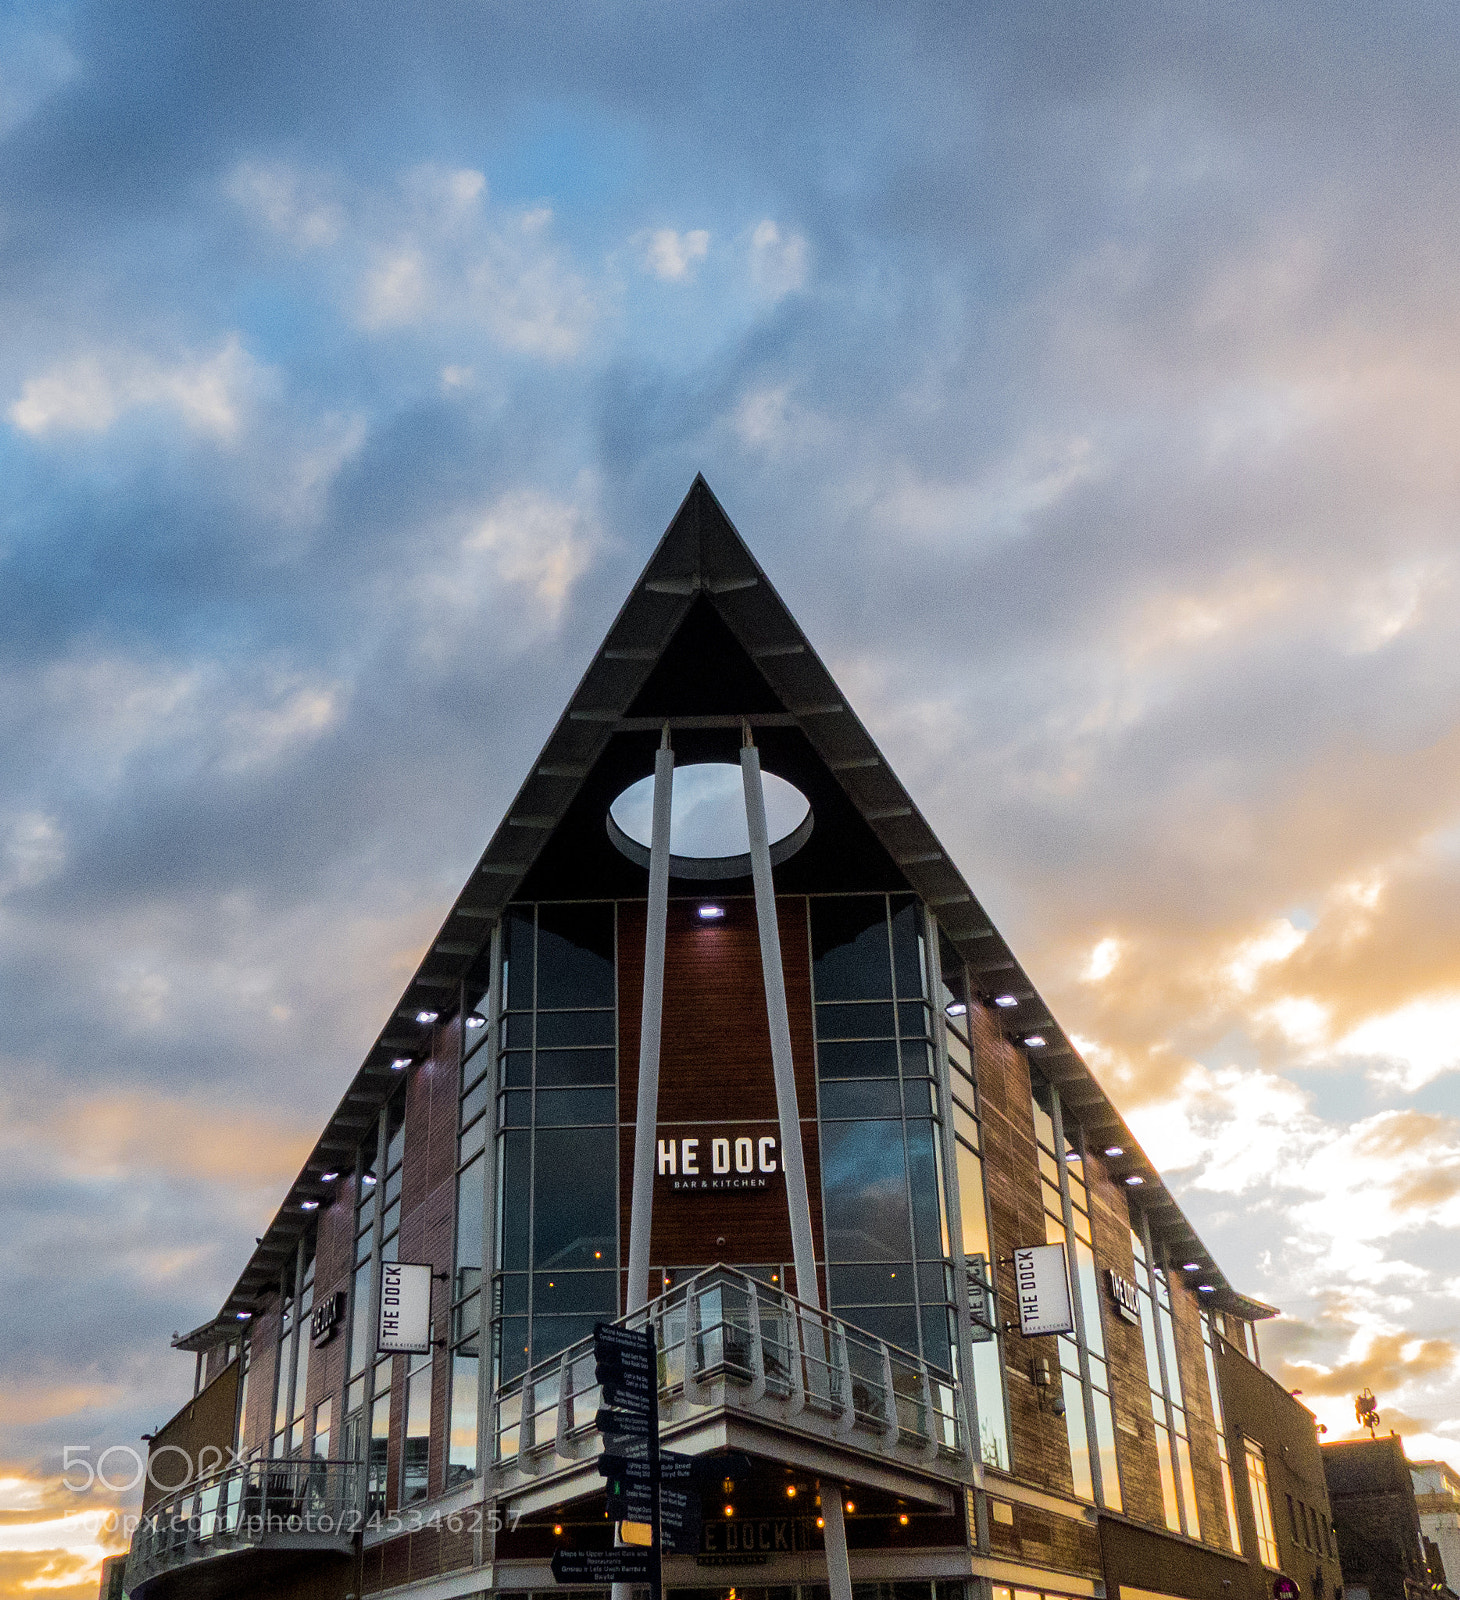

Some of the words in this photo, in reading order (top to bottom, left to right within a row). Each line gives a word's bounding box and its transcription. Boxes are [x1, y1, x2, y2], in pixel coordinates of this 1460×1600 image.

[658, 1139, 699, 1175] HE
[712, 1136, 785, 1174] DOC
[674, 1180, 697, 1189] BAR
[701, 1180, 708, 1188] &
[712, 1179, 766, 1187] KITCHEN
[384, 1266, 401, 1306] DOCK
[1017, 1251, 1036, 1290] DOCK
[382, 1311, 399, 1338] THE
[1022, 1295, 1040, 1323] THE
